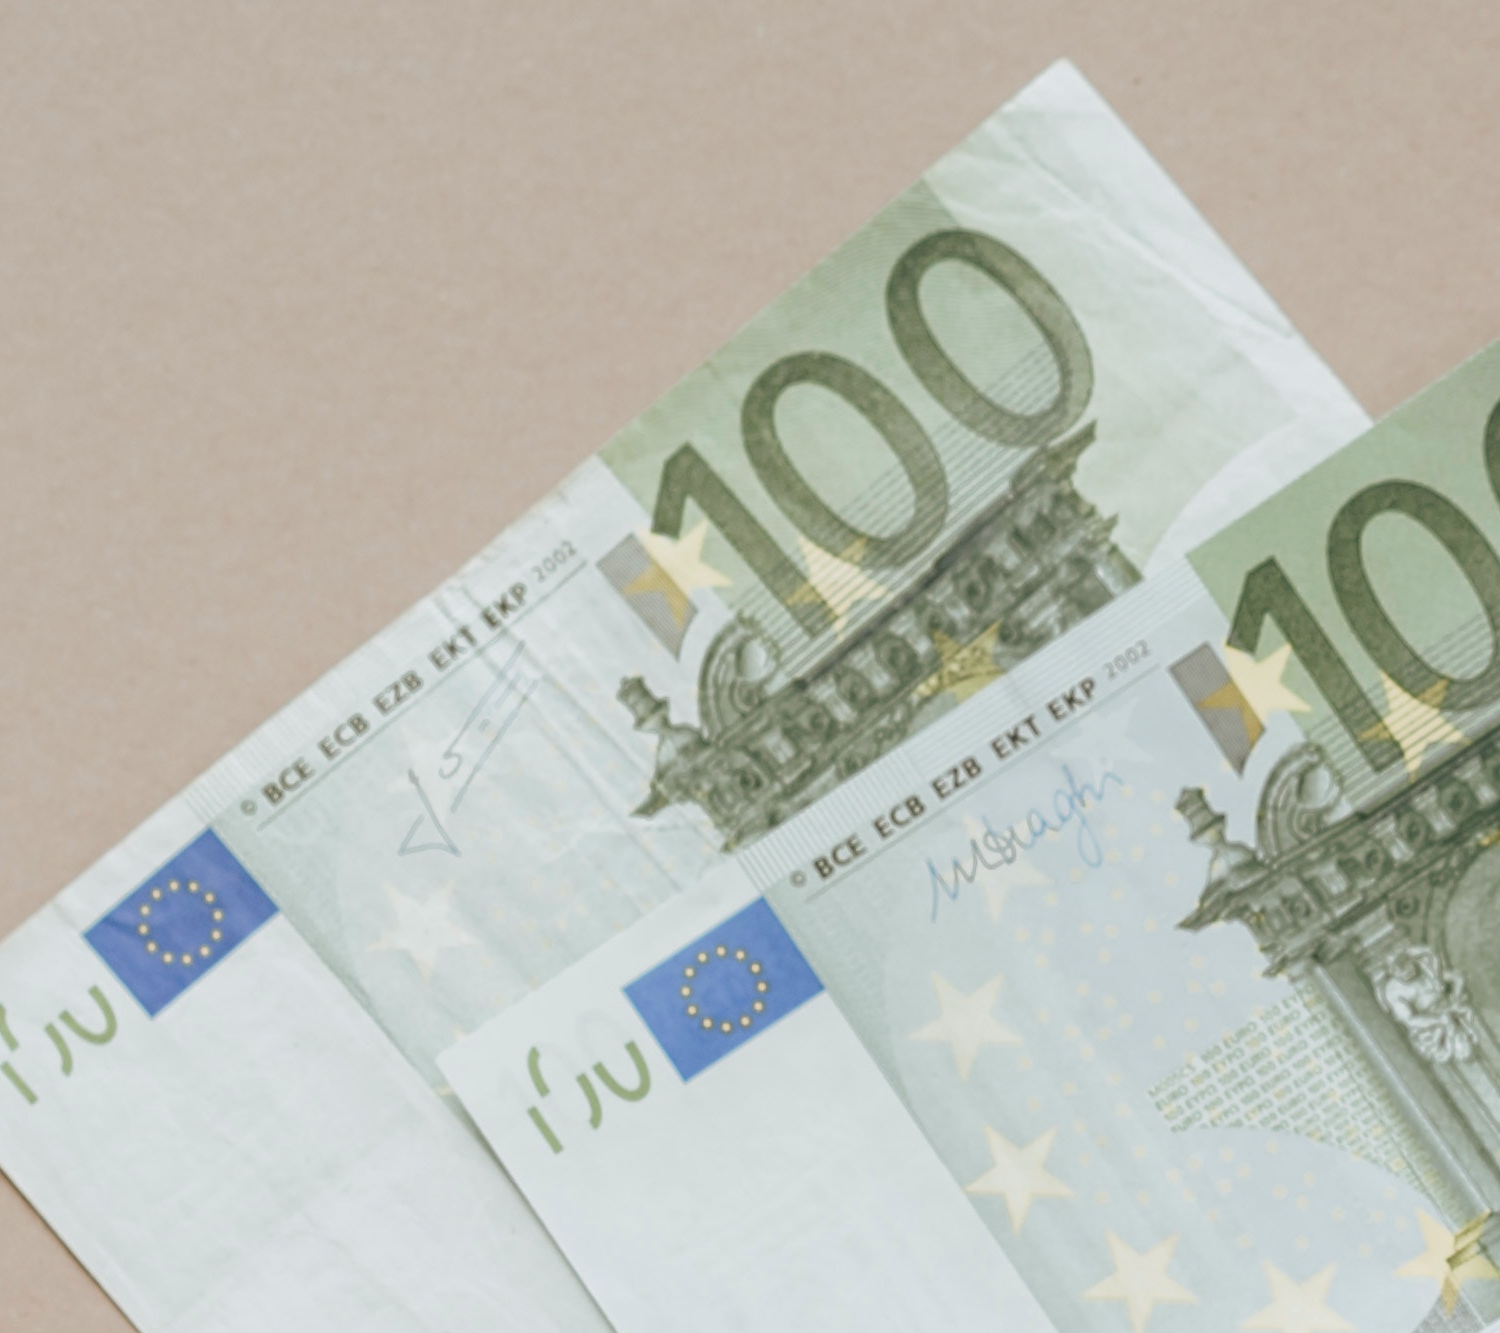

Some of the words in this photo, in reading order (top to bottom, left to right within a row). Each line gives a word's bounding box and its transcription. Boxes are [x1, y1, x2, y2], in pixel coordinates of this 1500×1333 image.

[651, 228, 1094, 640] 100
[261, 758, 313, 806] BCE
[317, 713, 371, 761] ECB
[372, 670, 424, 716] EZB
[427, 624, 480, 672] EKT
[480, 582, 527, 629] EKP
[531, 539, 580, 585] 2002
[812, 834, 867, 880] BCE
[872, 794, 926, 840] ECB
[931, 756, 982, 800] EZB
[990, 714, 1040, 760] EKT
[1046, 677, 1096, 722] EKP
[1104, 639, 1151, 680] 2002
